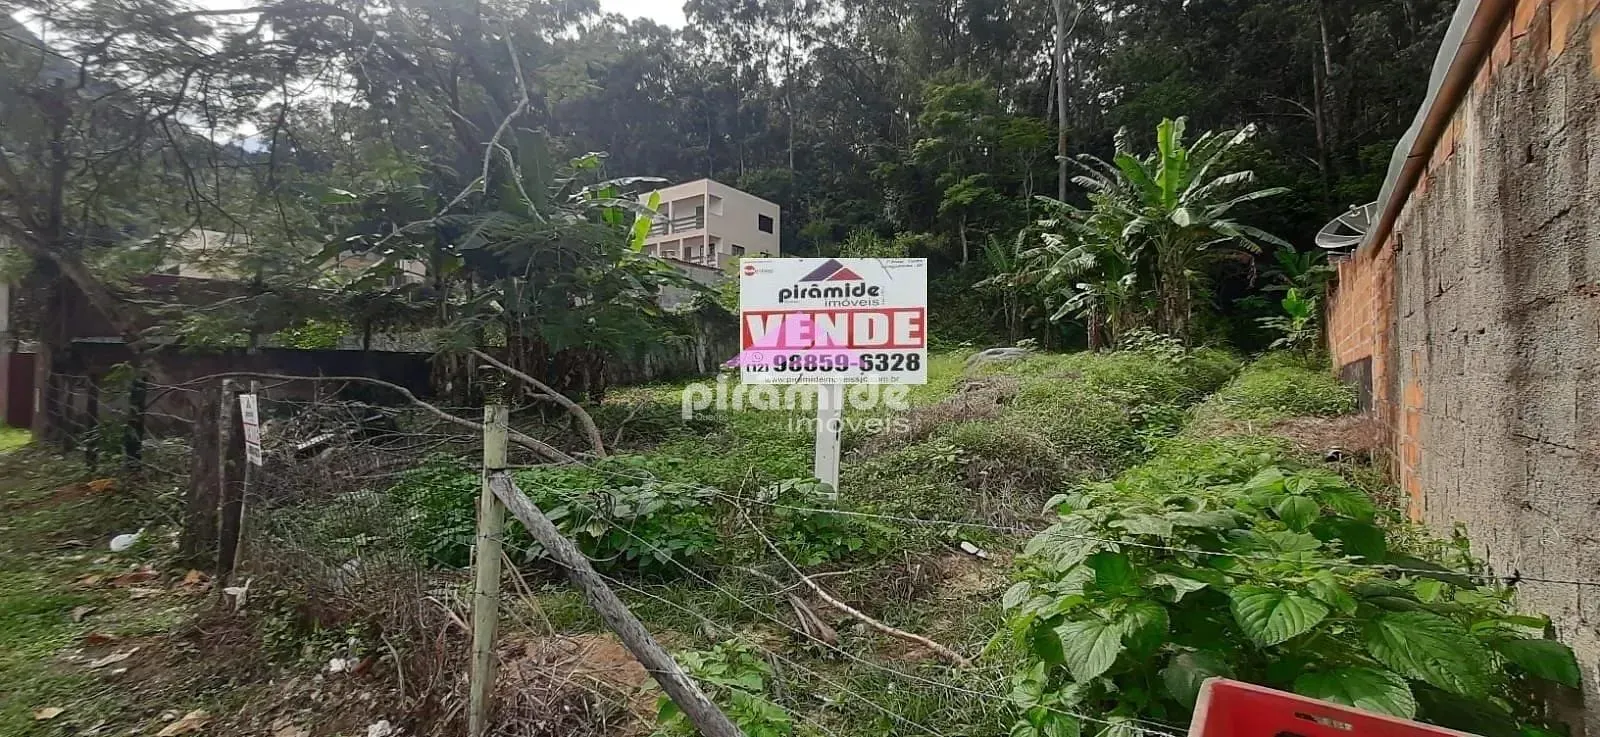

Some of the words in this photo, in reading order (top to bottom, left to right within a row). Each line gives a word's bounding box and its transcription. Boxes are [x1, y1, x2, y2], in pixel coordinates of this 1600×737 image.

[778, 282, 880, 304] pirâmide
[824, 297, 880, 308] imóveis
[746, 311, 922, 349] VENDE
[746, 363, 769, 373] (12)
[773, 352, 921, 373] 98859-6328
